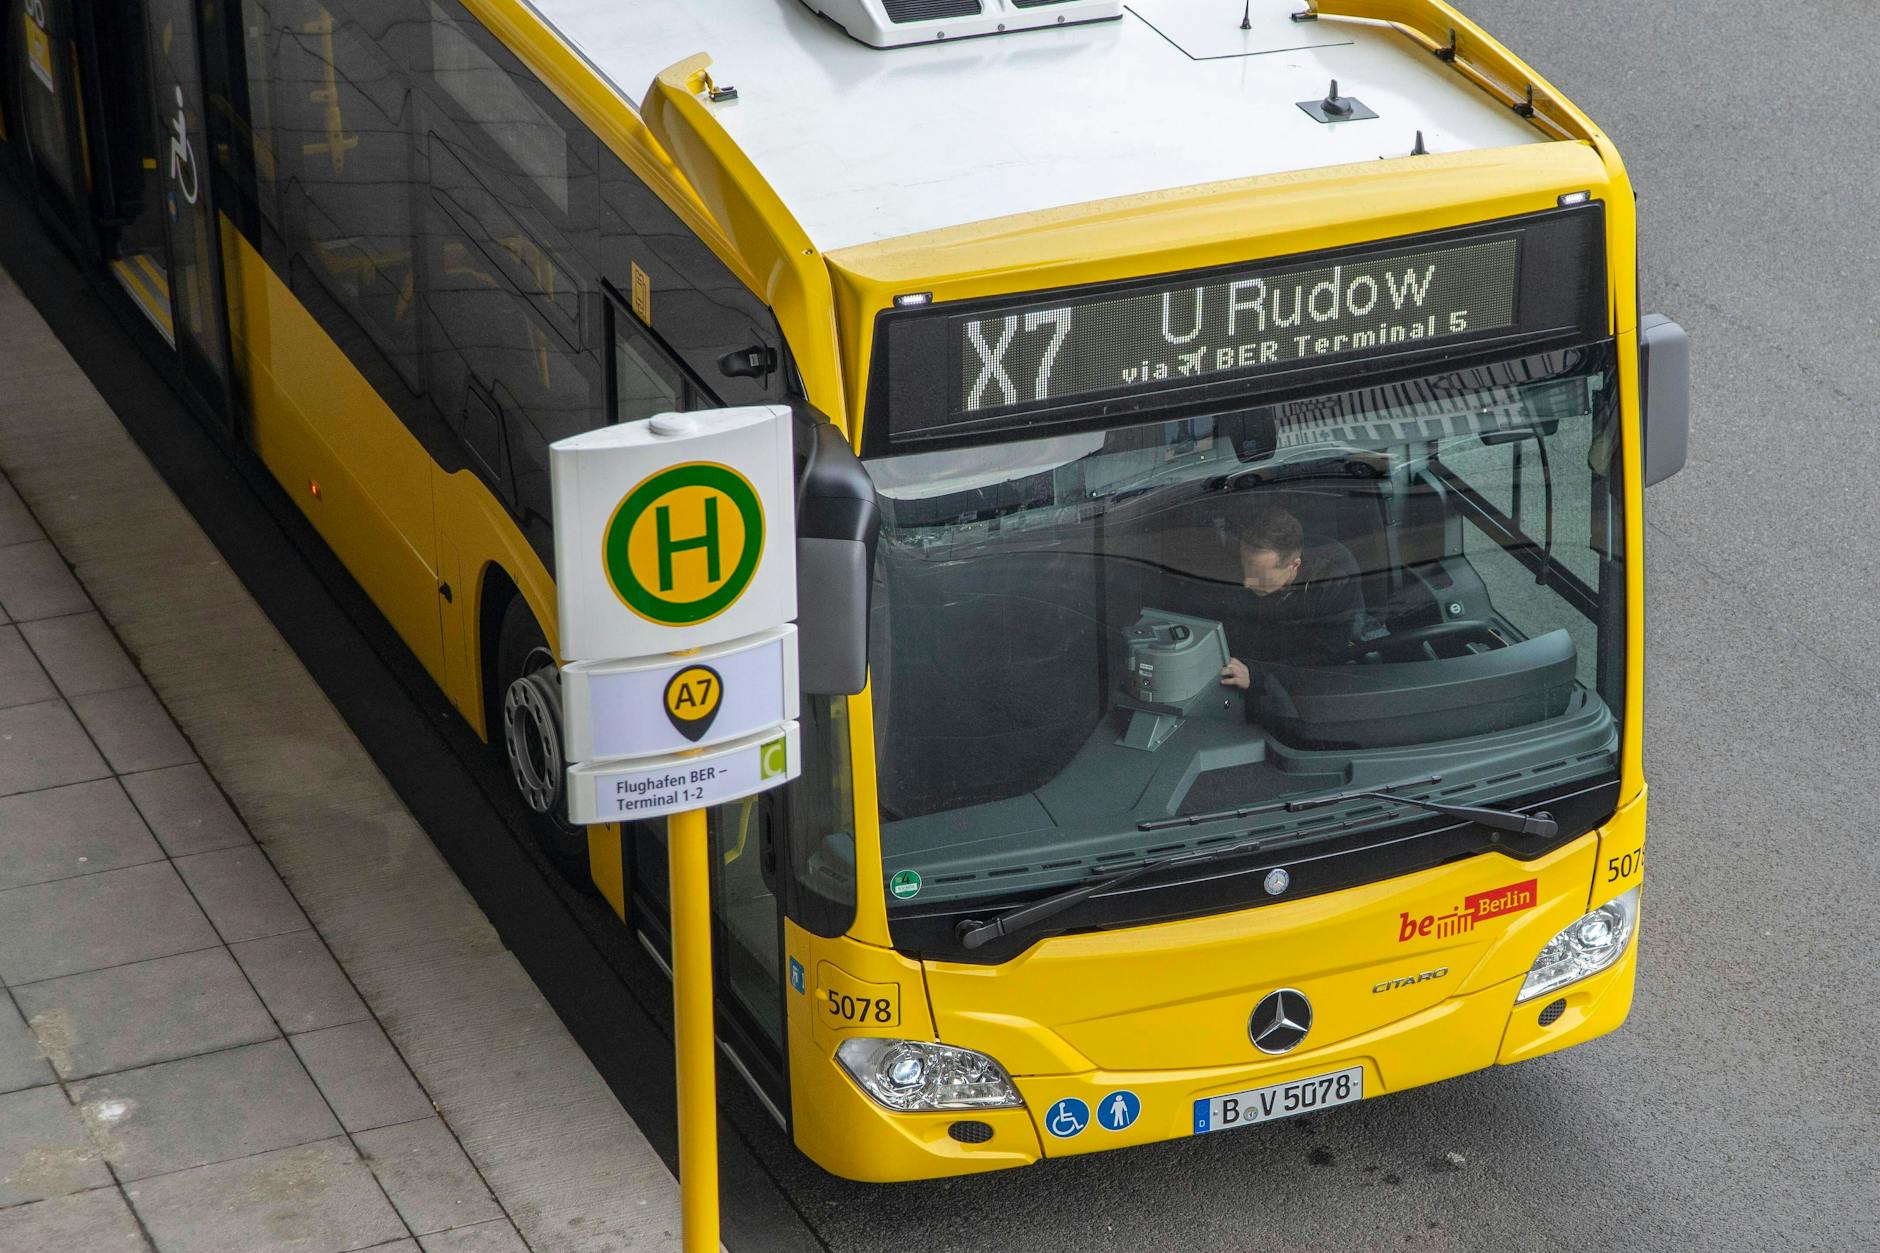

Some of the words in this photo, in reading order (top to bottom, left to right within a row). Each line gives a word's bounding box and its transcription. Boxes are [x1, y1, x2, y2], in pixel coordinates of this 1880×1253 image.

[1162, 286, 1203, 345] U
[1228, 265, 1436, 337] Rudow
[964, 307, 1072, 412] X7
[1122, 361, 1168, 384] via
[1216, 341, 1279, 371] BER
[1293, 315, 1436, 357] Terminal
[1449, 310, 1468, 333] 5
[655, 496, 721, 592] H
[674, 678, 712, 710] A7
[763, 743, 782, 776] C
[616, 774, 686, 795] Flughafen
[690, 767, 716, 783] BER
[617, 790, 678, 811] Terminal
[682, 787, 704, 802] 1-2
[1478, 889, 1531, 916] Berlin
[1372, 967, 1449, 994] CITARO
[827, 988, 892, 1024] 5078
[1223, 1098, 1240, 1125] B
[1260, 1090, 1277, 1117] V
[1284, 1074, 1351, 1112] 5078
[1199, 1119, 1206, 1128] D
